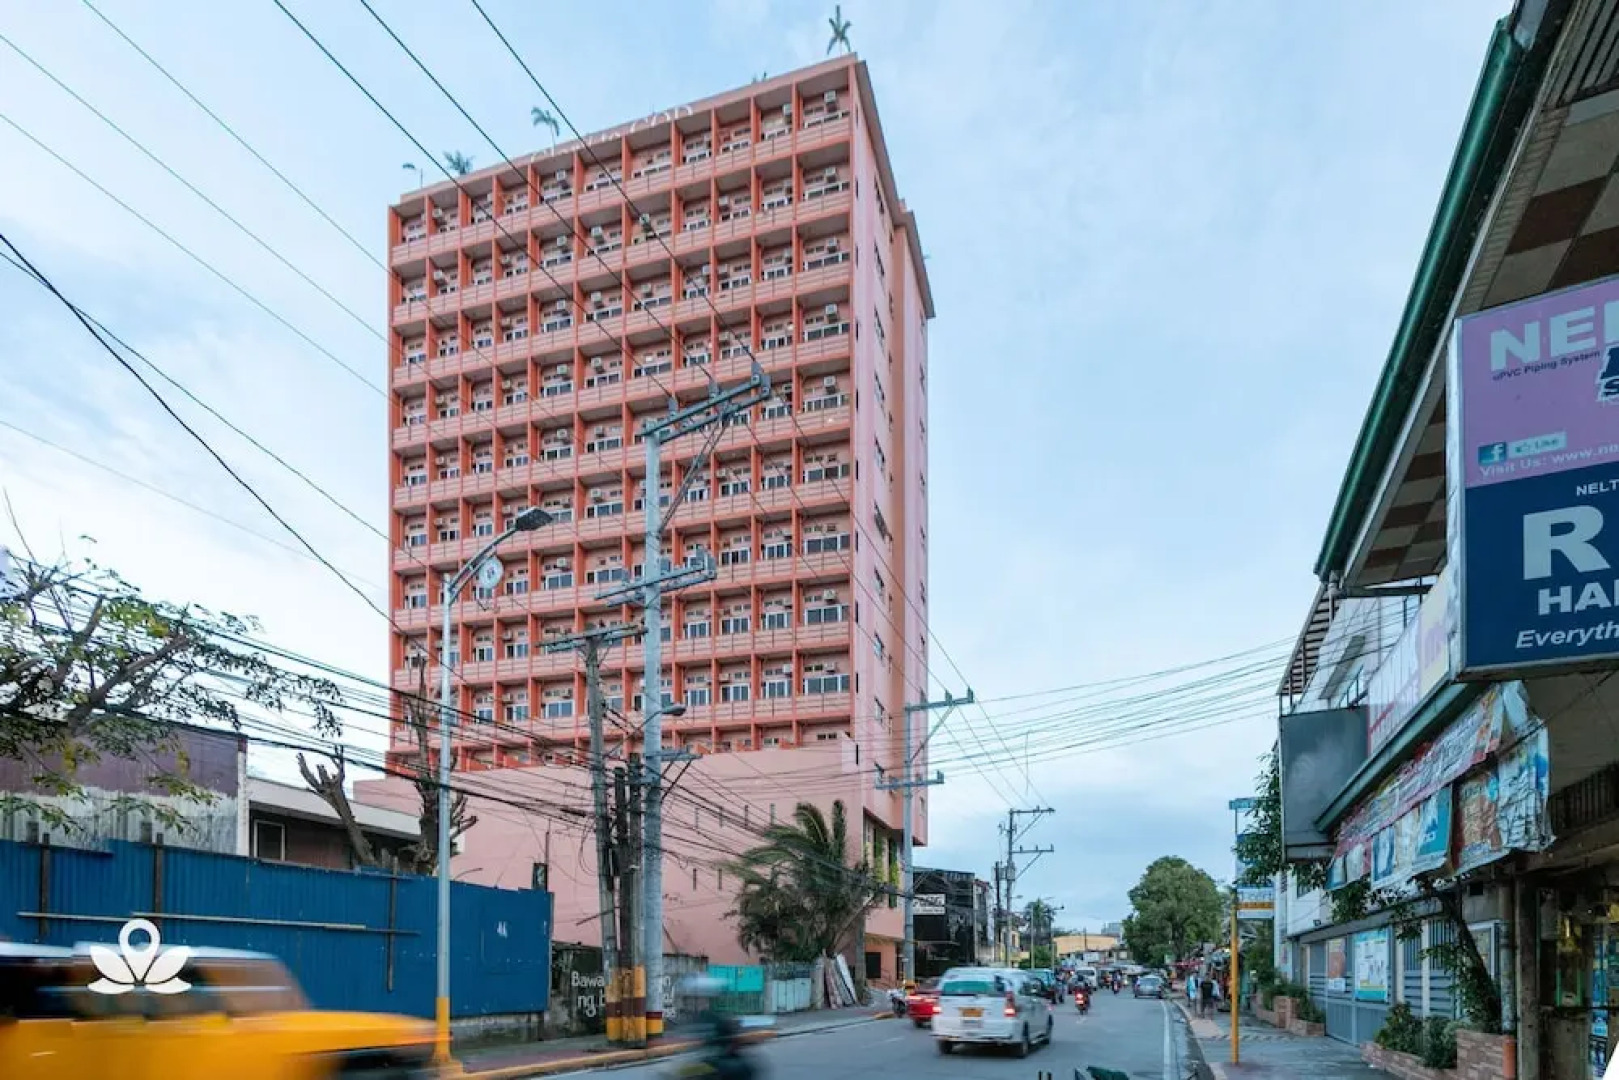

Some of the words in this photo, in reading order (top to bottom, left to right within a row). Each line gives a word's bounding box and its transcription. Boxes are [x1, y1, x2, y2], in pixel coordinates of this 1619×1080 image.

[1524, 361, 1557, 375] Piping
[1560, 351, 1600, 366] System
[1480, 463, 1515, 477] Visit
[571, 971, 605, 987] Bawa
